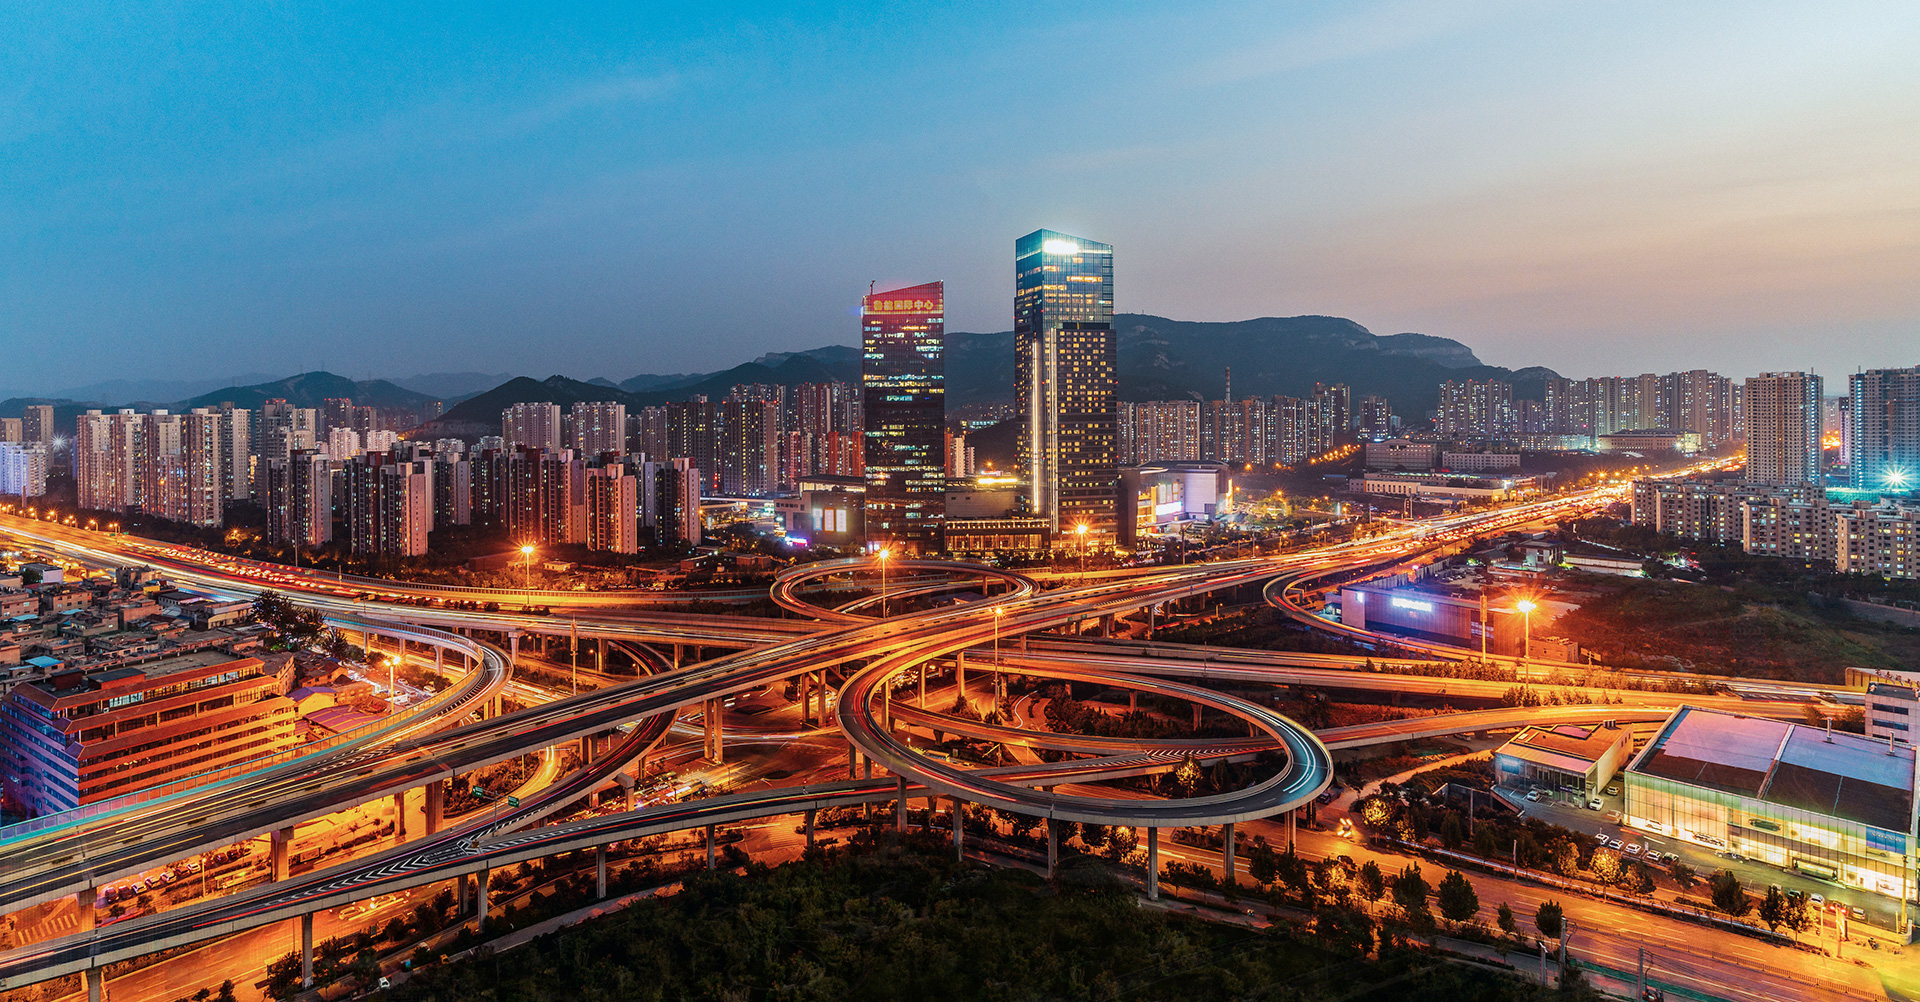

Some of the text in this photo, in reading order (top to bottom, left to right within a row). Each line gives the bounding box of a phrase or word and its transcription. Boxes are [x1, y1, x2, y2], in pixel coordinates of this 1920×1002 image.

[873, 300, 934, 311] 鲁能国际中心
